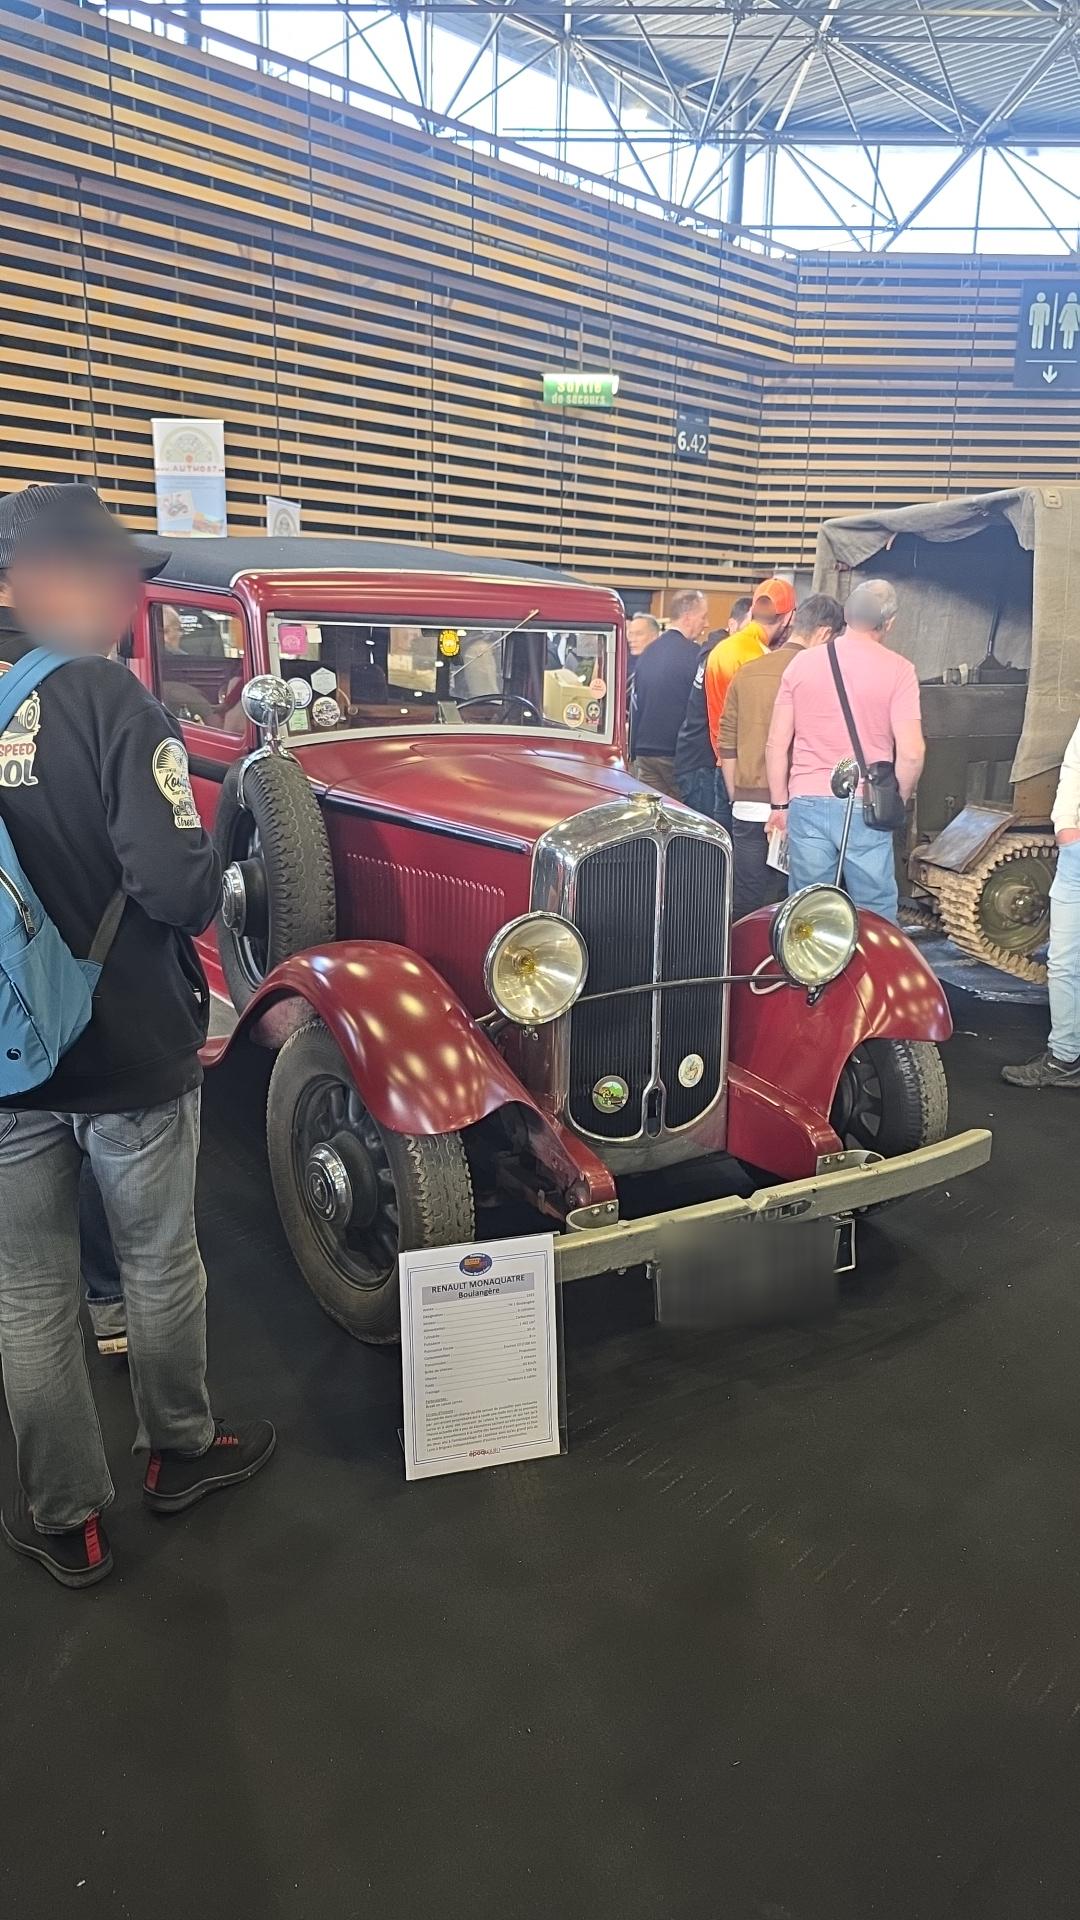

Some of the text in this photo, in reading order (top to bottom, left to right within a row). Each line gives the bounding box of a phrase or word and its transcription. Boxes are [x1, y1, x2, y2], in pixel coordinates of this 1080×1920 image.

[557, 381, 602, 393] Sortie
[552, 392, 605, 405] de secours
[677, 431, 707, 454] 6.42
[0, 743, 35, 757] SPEED
[0, 759, 37, 785] OL
[431, 1274, 525, 1294] RENAULT MONAQUATRE
[458, 1287, 500, 1299] Boulangère
